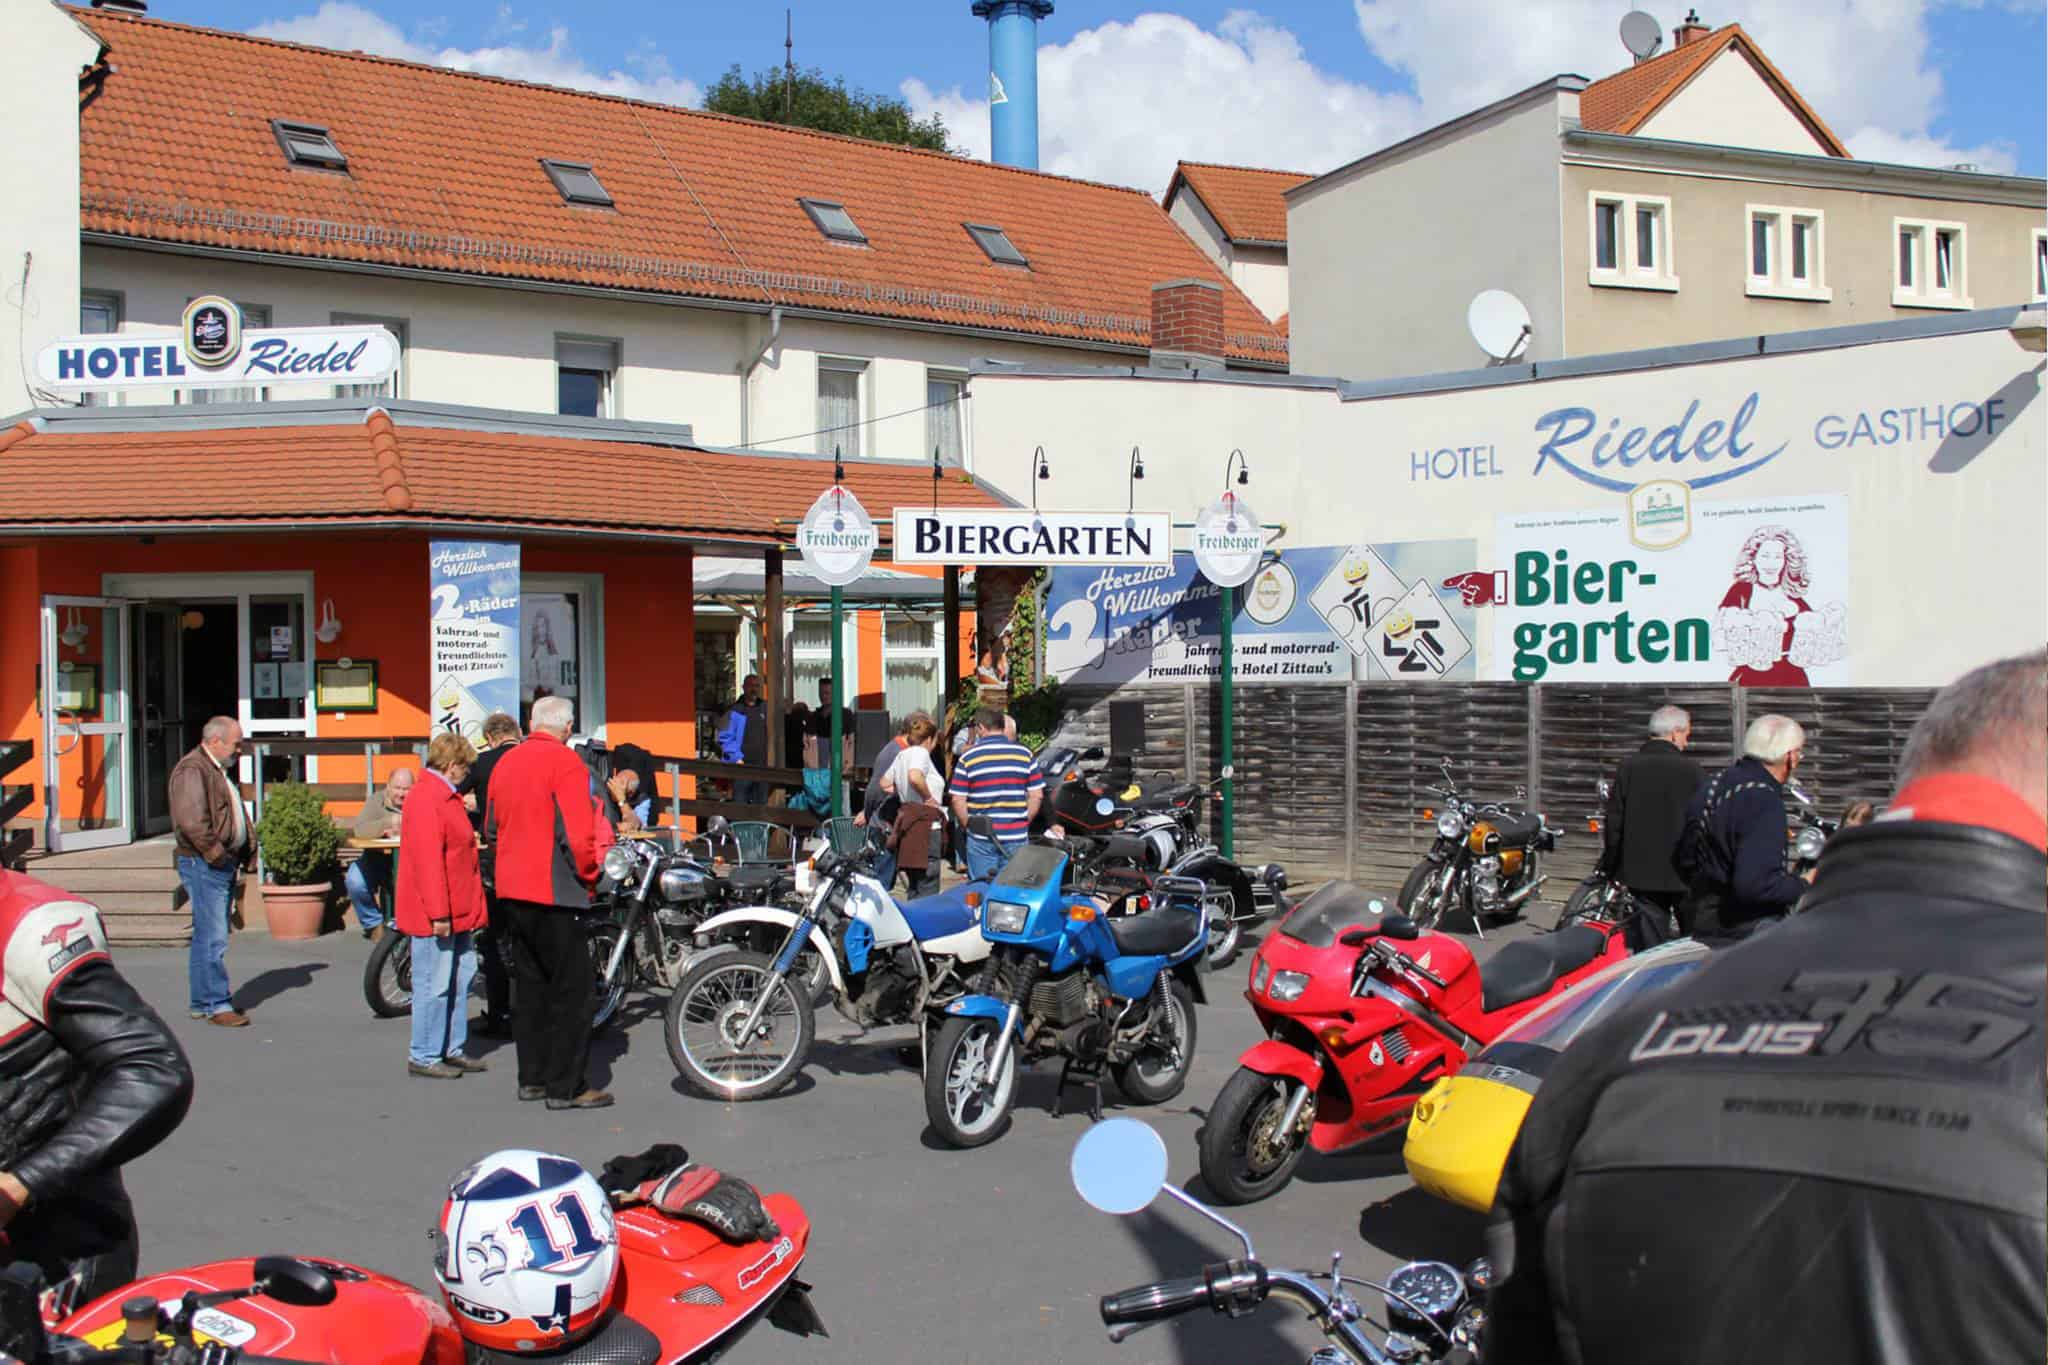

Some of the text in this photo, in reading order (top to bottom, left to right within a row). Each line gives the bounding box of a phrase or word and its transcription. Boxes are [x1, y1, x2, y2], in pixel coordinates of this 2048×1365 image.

[58, 338, 369, 379] HOTEL Riedel
[1411, 392, 2005, 492] HOTEL Riedel GASTHOF
[805, 530, 870, 549] Freiberger
[915, 518, 1151, 555] BIERGARTEN
[1198, 533, 1259, 553] Freiberger
[432, 546, 487, 569] Herzlich
[442, 560, 519, 577] Willkommen
[1514, 549, 1656, 607] Bier-
[1241, 644, 1268, 655] und
[1512, 611, 1710, 682] garten
[438, 663, 468, 673] Hotel
[1148, 660, 1333, 679] freundlichstn Hotel Zittau's
[506, 1191, 603, 1269] 11
